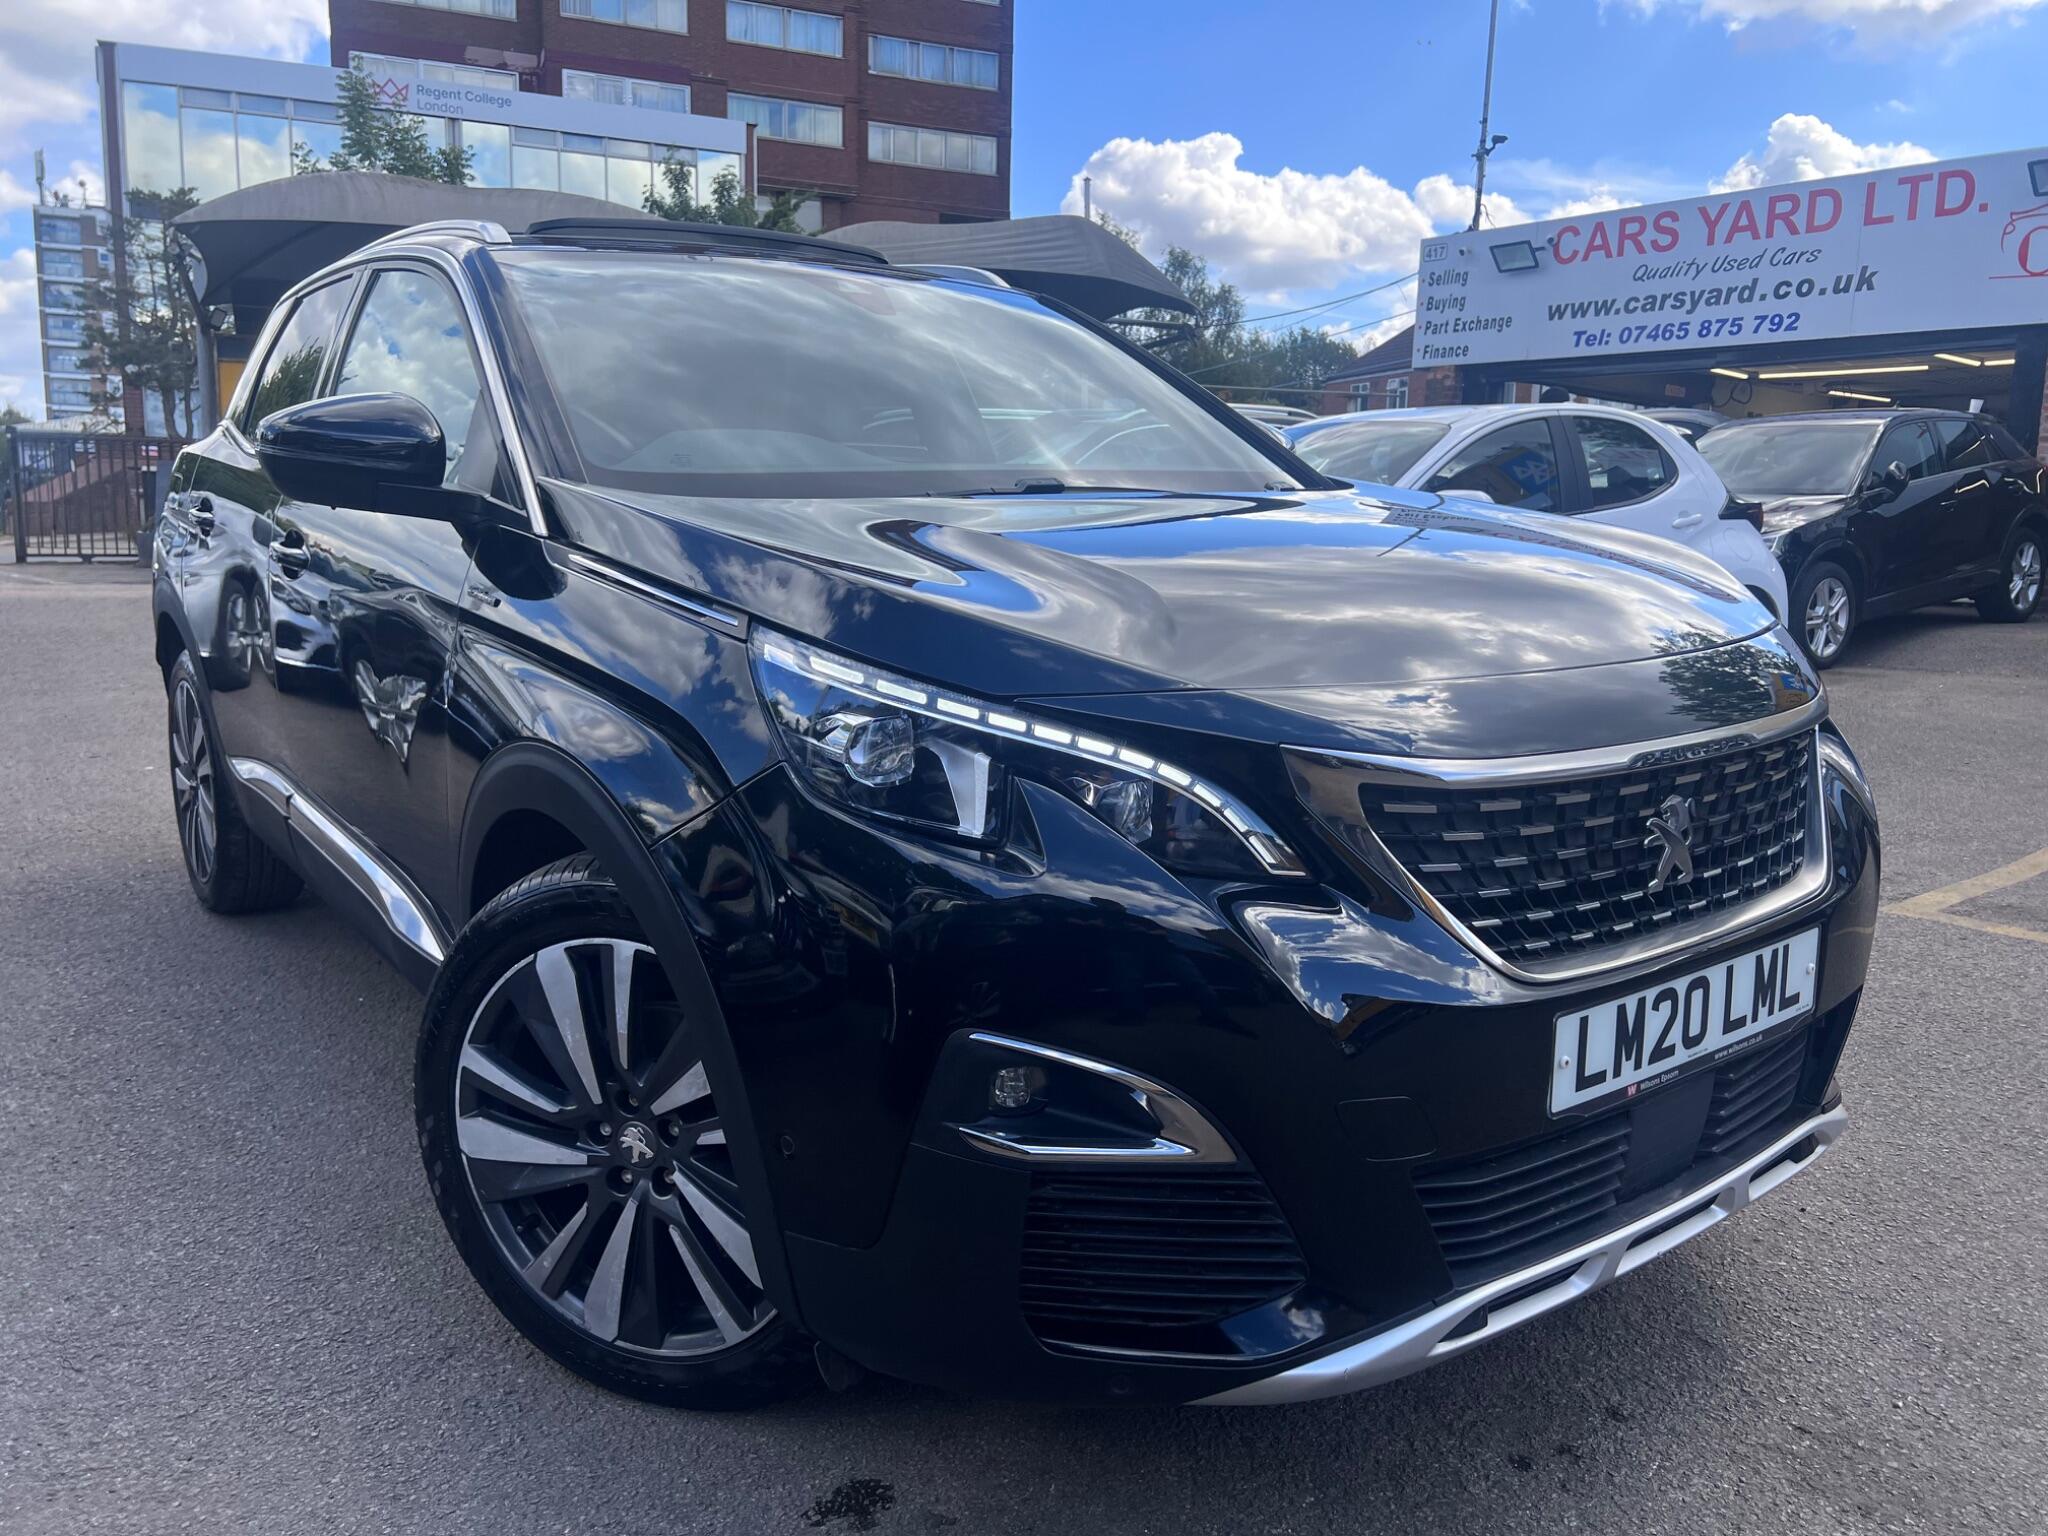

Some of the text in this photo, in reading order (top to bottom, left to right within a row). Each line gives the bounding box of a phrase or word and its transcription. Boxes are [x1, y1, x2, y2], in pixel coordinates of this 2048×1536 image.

[416, 84, 512, 108] Regent College
[417, 100, 464, 115] London
[1552, 169, 1989, 265] CARS YARD LTD.
[1425, 246, 1446, 260] 417
[1633, 247, 1822, 282] Quality Used Cars
[1428, 270, 1468, 287] Selling
[1426, 294, 1466, 313] Buying
[1548, 265, 1879, 321] www.carsyard.co.uk
[1424, 315, 1512, 335] Part Exchange
[1573, 312, 1801, 348] Tel: 07465 875 792
[1422, 344, 1469, 359] Finance
[1575, 944, 1800, 1093] LM20 LML
[1640, 1077, 1661, 1091] Wilsons
[1661, 1070, 1679, 1083] Epsom
